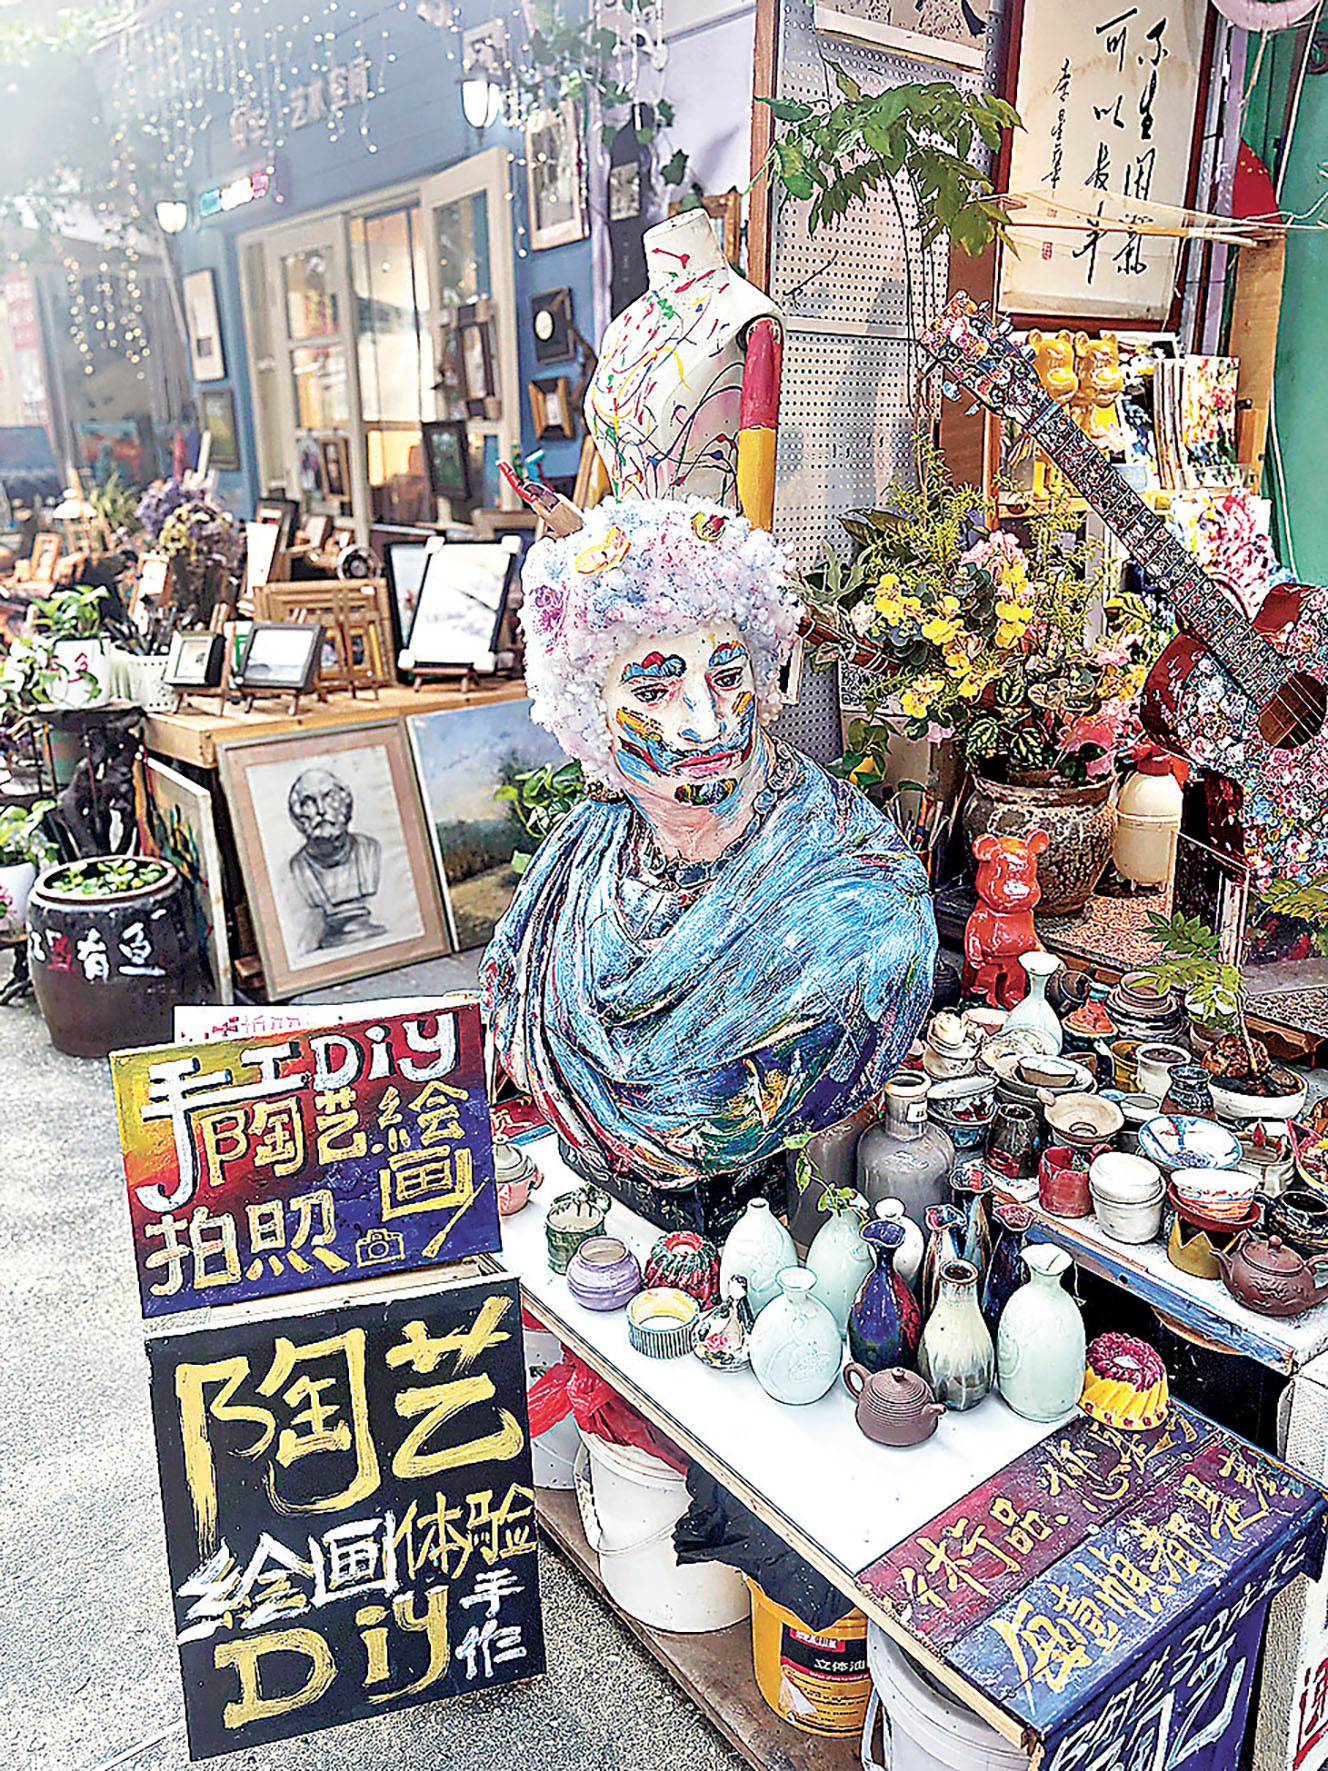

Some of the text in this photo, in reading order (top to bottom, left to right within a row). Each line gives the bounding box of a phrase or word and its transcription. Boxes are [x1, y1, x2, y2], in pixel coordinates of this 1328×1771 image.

[145, 1189, 351, 1297] 拍照
[174, 1296, 524, 1558] 陶艺
[455, 1568, 527, 1680] 手作
